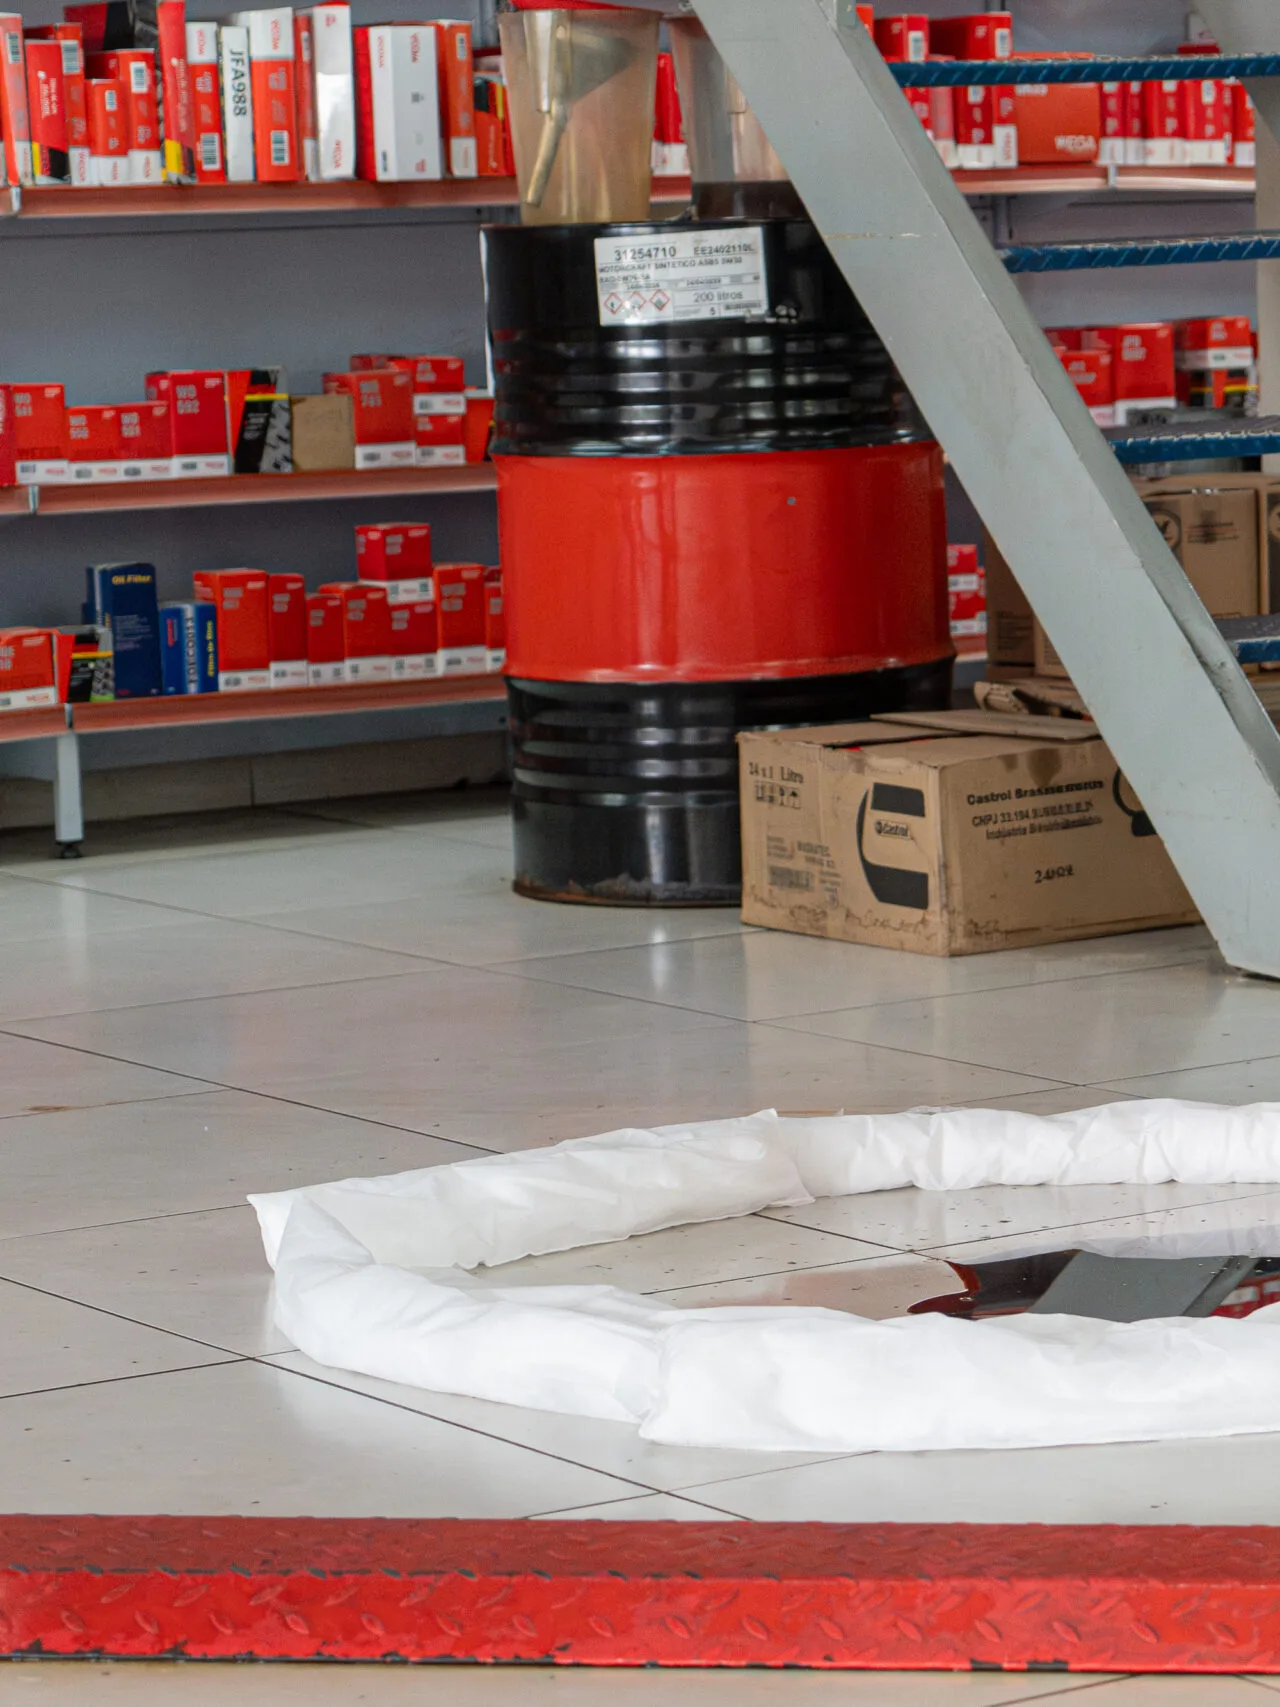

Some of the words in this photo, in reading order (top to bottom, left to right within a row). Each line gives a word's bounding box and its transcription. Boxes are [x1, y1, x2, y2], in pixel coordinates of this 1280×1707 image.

[230, 49, 248, 118] JFA988
[614, 246, 677, 261] 31254710
[693, 292, 714, 303] 200
[967, 790, 1012, 805] Castrol
